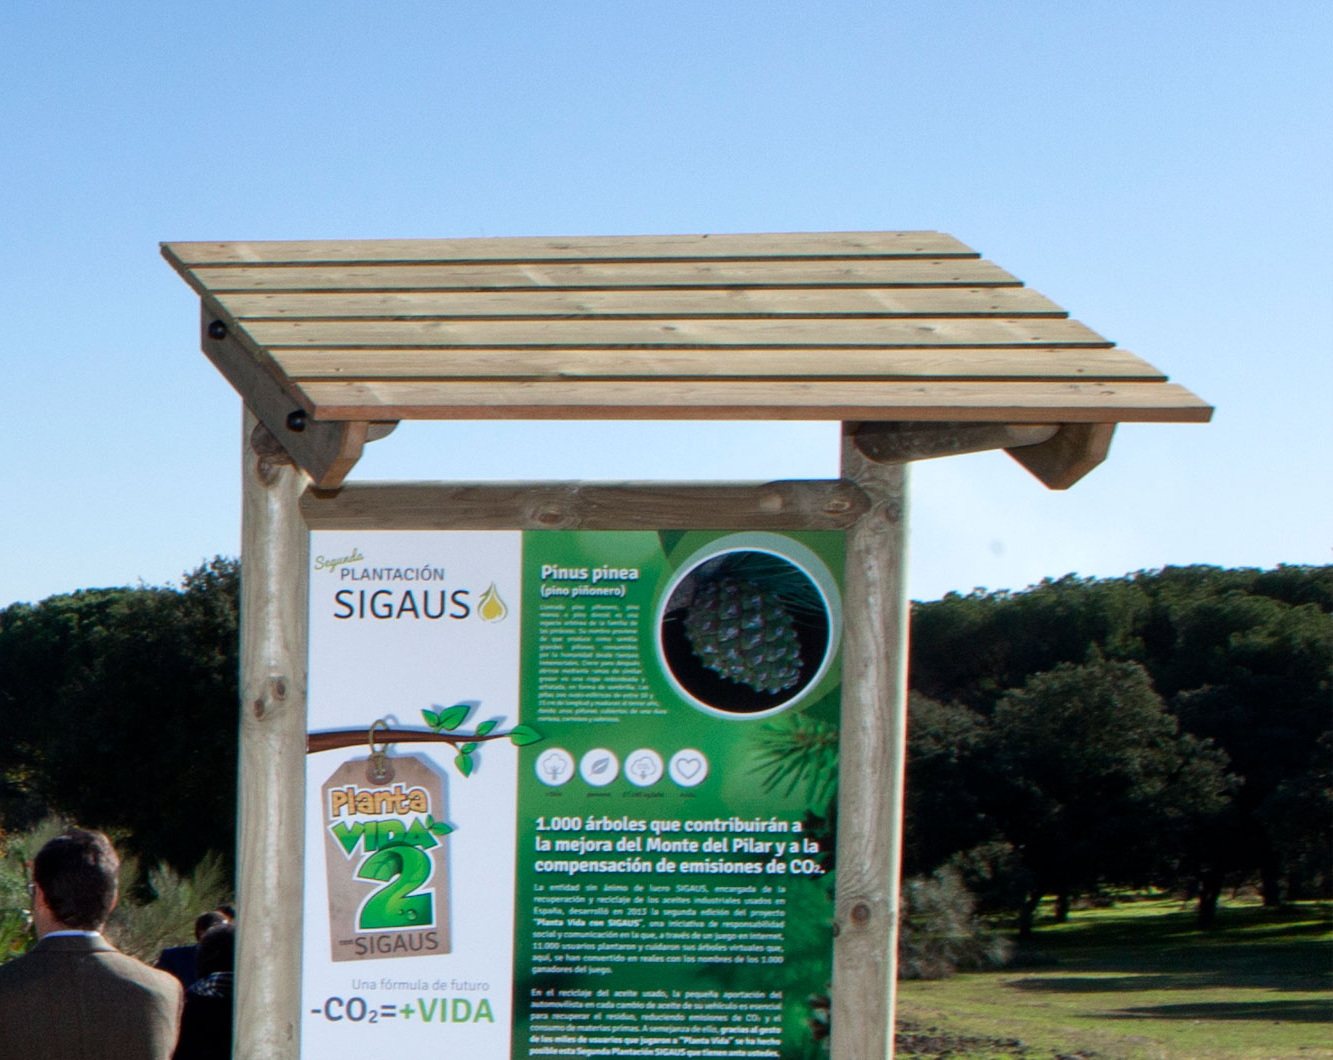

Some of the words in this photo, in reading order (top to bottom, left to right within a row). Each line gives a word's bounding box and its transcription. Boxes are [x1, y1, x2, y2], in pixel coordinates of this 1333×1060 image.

[341, 565, 445, 581] PLANTACIÓN
[541, 565, 588, 580] Pinus
[592, 565, 639, 583] pinea
[540, 585, 569, 598] (pino
[571, 585, 626, 598] piñonero)
[334, 589, 470, 619] SIGAUS
[331, 785, 428, 817] Planta
[535, 817, 582, 831] 1.000
[585, 816, 647, 832] árboles
[650, 820, 681, 835] que
[684, 817, 787, 832] contribuirán
[792, 821, 802, 832] a
[331, 817, 438, 854] VIDA
[535, 837, 550, 851] la
[555, 838, 612, 855] mejora
[616, 837, 642, 852] del
[646, 838, 699, 853] Monte
[702, 838, 729, 853] del
[732, 838, 773, 853] Pilar
[775, 842, 787, 857] y
[789, 842, 800, 853] a
[803, 838, 819, 854] la
[534, 857, 652, 875] compensación
[656, 858, 675, 873] de
[680, 859, 763, 874] emisiones
[766, 859, 786, 874] de
[357, 843, 433, 929] 2
[355, 931, 439, 955] SIGAUS
[352, 979, 377, 990] Una
[381, 978, 429, 990] fórmula
[432, 979, 447, 990] de
[451, 979, 490, 991] futuro
